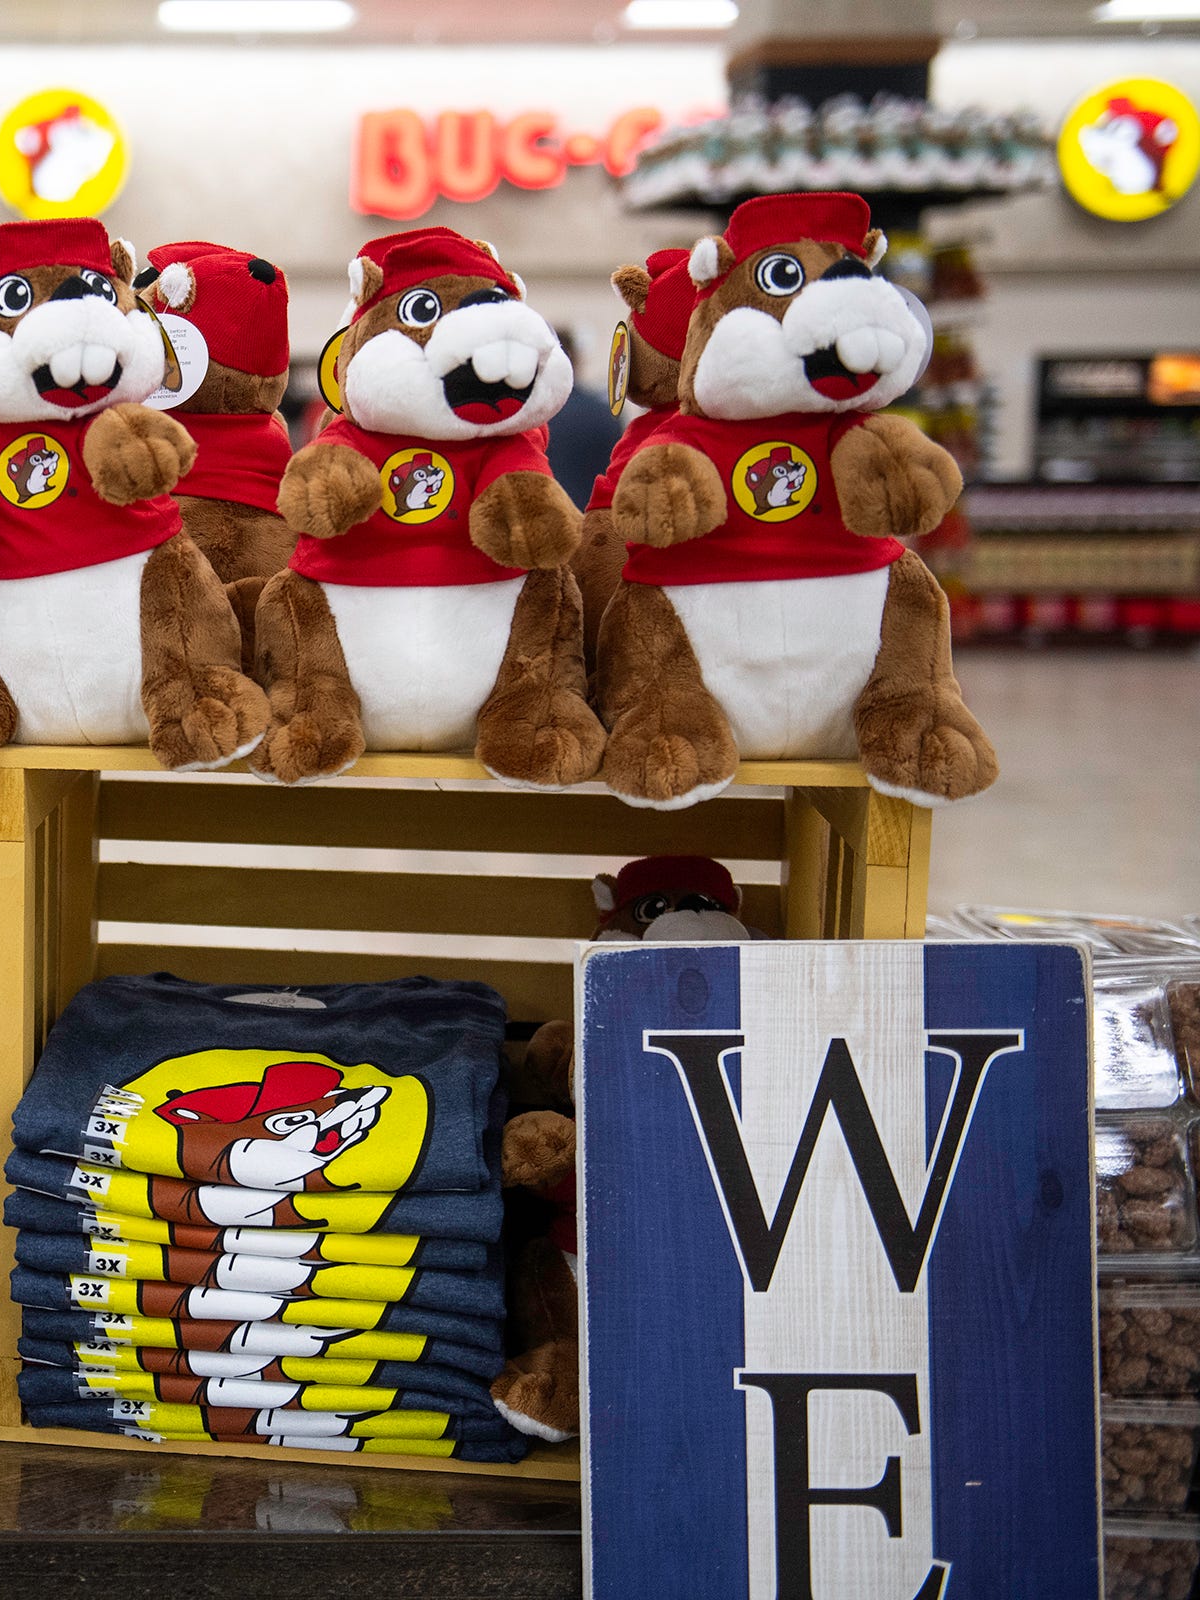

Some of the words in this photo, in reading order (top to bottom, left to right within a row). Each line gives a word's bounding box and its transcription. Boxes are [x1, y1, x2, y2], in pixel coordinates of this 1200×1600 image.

[94, 1121, 120, 1136] 3X
[90, 1152, 115, 1165] 3X
[79, 1172, 104, 1189] 3X
[95, 1258, 121, 1273] 3X
[78, 1283, 104, 1298] 3X
[101, 1312, 126, 1324] 3X
[120, 1400, 145, 1415] 3X
